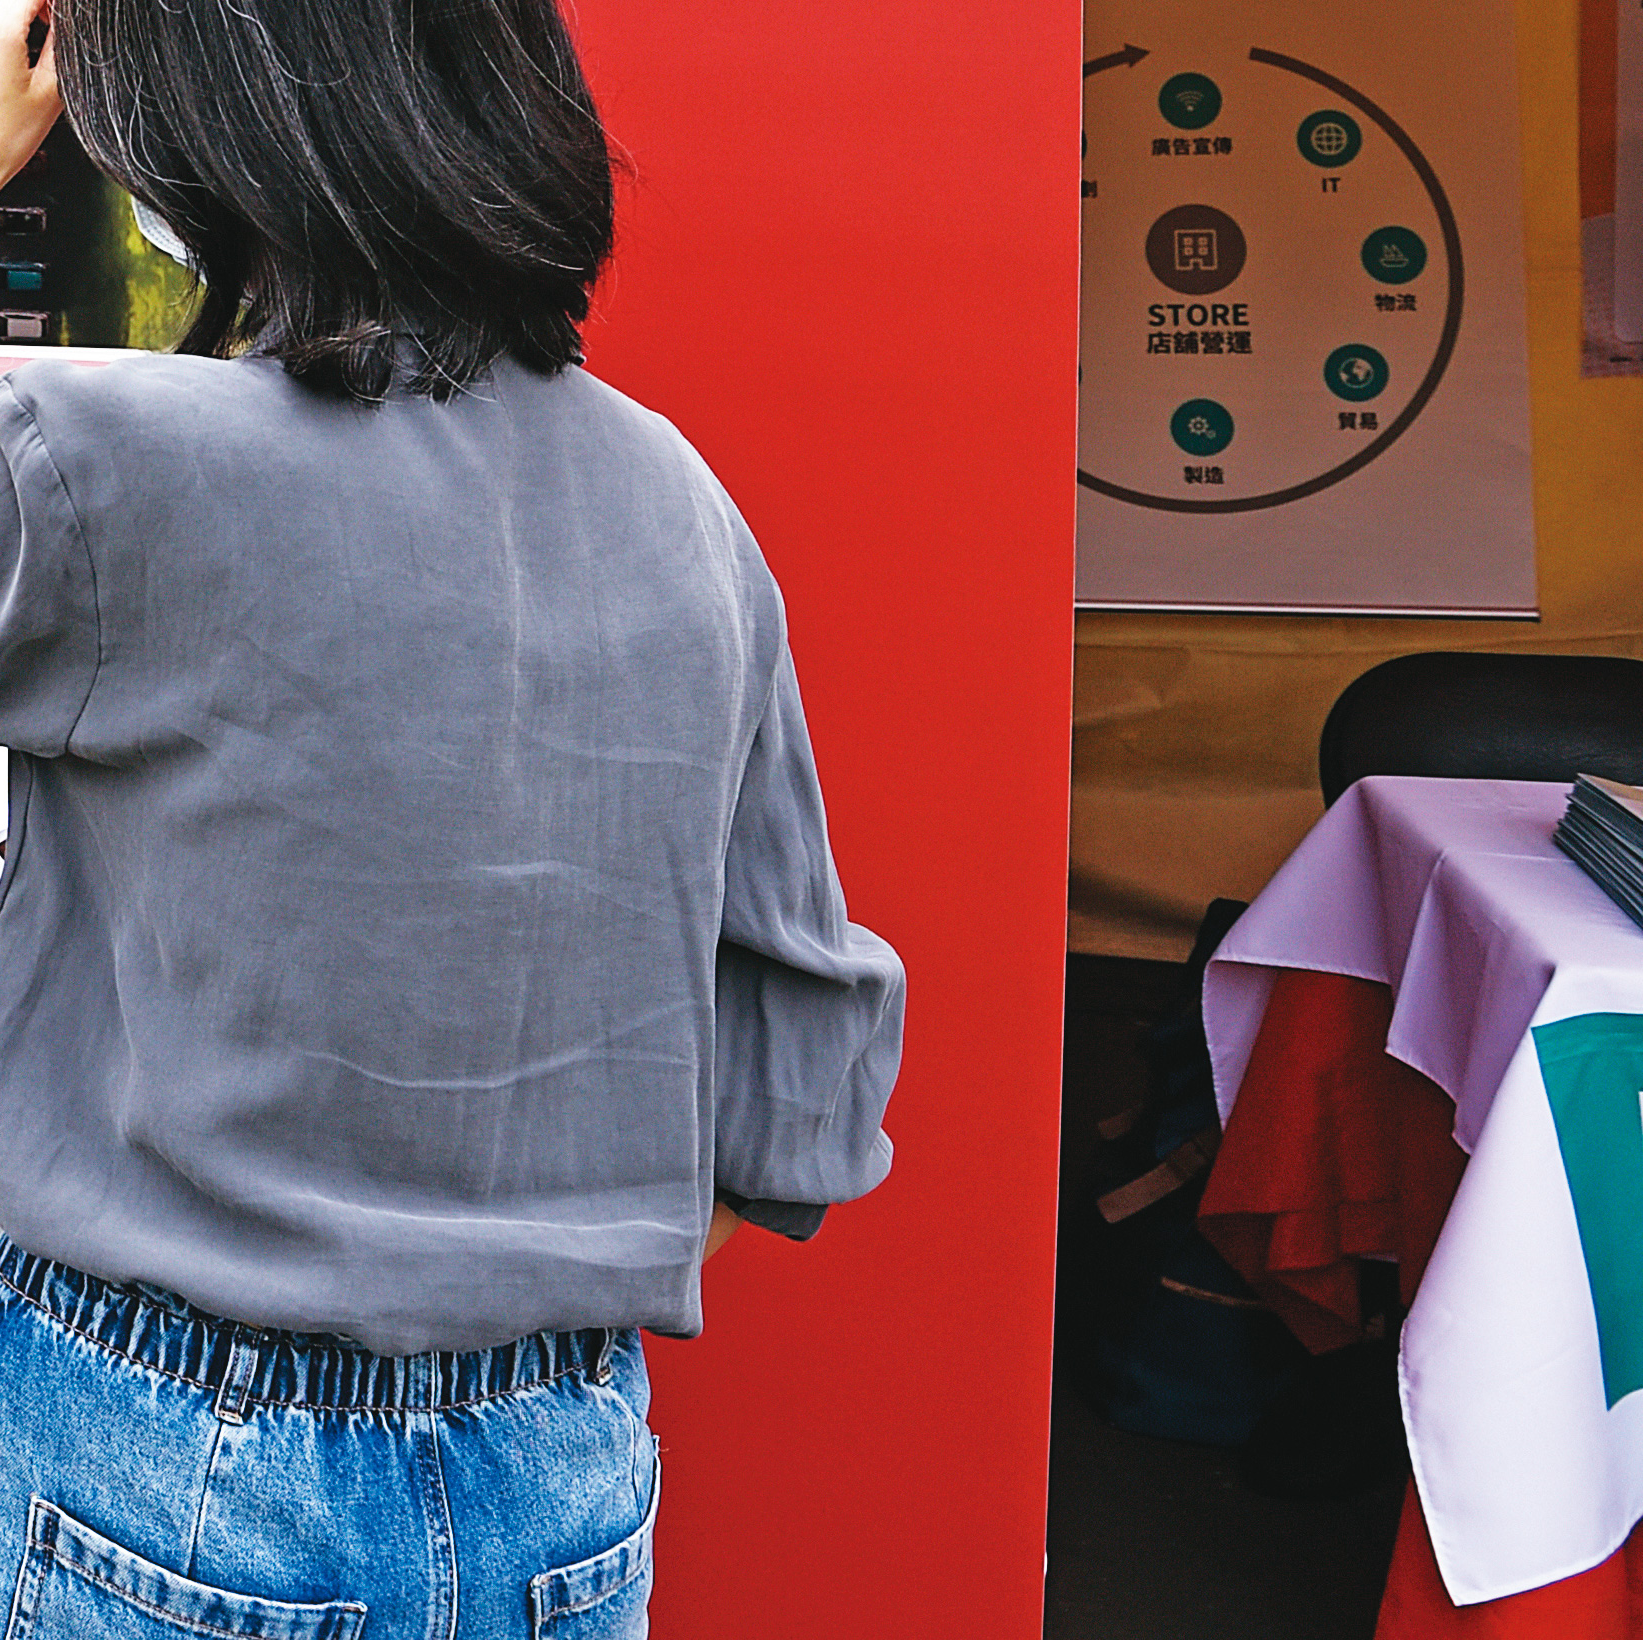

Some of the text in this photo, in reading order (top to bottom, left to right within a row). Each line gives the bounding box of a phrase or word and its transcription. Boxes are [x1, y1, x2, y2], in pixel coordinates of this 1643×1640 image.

[1152, 137, 1233, 156] 廣告宣傳
[1321, 177, 1342, 193] IT
[1374, 294, 1417, 312] 物流
[1147, 303, 1250, 327] STORE
[1183, 466, 1225, 485] 製造
